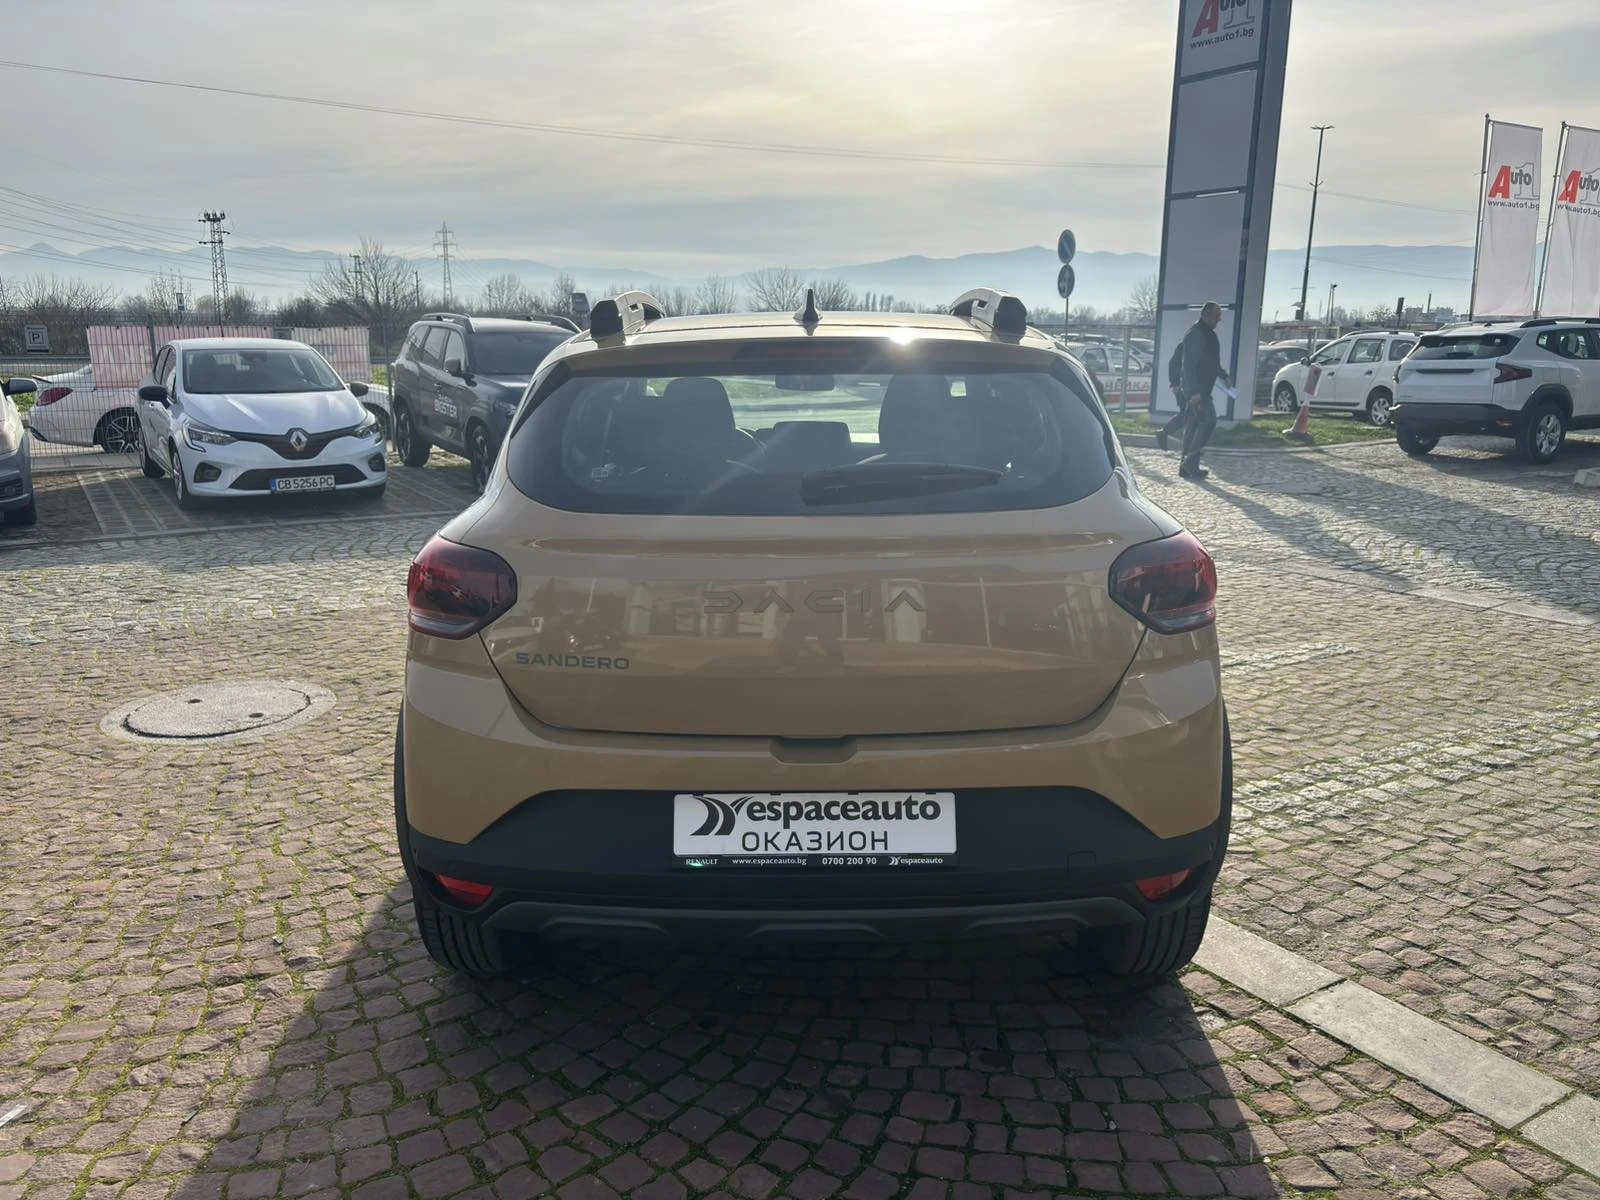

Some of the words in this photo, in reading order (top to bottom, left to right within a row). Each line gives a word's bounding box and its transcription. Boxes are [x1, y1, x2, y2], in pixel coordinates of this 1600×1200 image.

[1190, 27, 1254, 49] www.auto1.bg
[1487, 200, 1540, 211] www.auto1.bg
[277, 479, 291, 490] CB
[293, 478, 318, 489] 5256
[320, 476, 333, 487] PC
[704, 589, 927, 614] DACIA
[515, 652, 630, 670] SANDERO
[746, 794, 942, 830] espaceauto
[741, 830, 889, 852] ОКАЗИОН
[685, 858, 719, 866] RENAULT
[731, 857, 807, 866] www.espaceauto.bg
[821, 857, 845, 866] 0700
[846, 857, 864, 866] 200
[865, 857, 878, 866] 90
[899, 857, 944, 866] espaceauto
